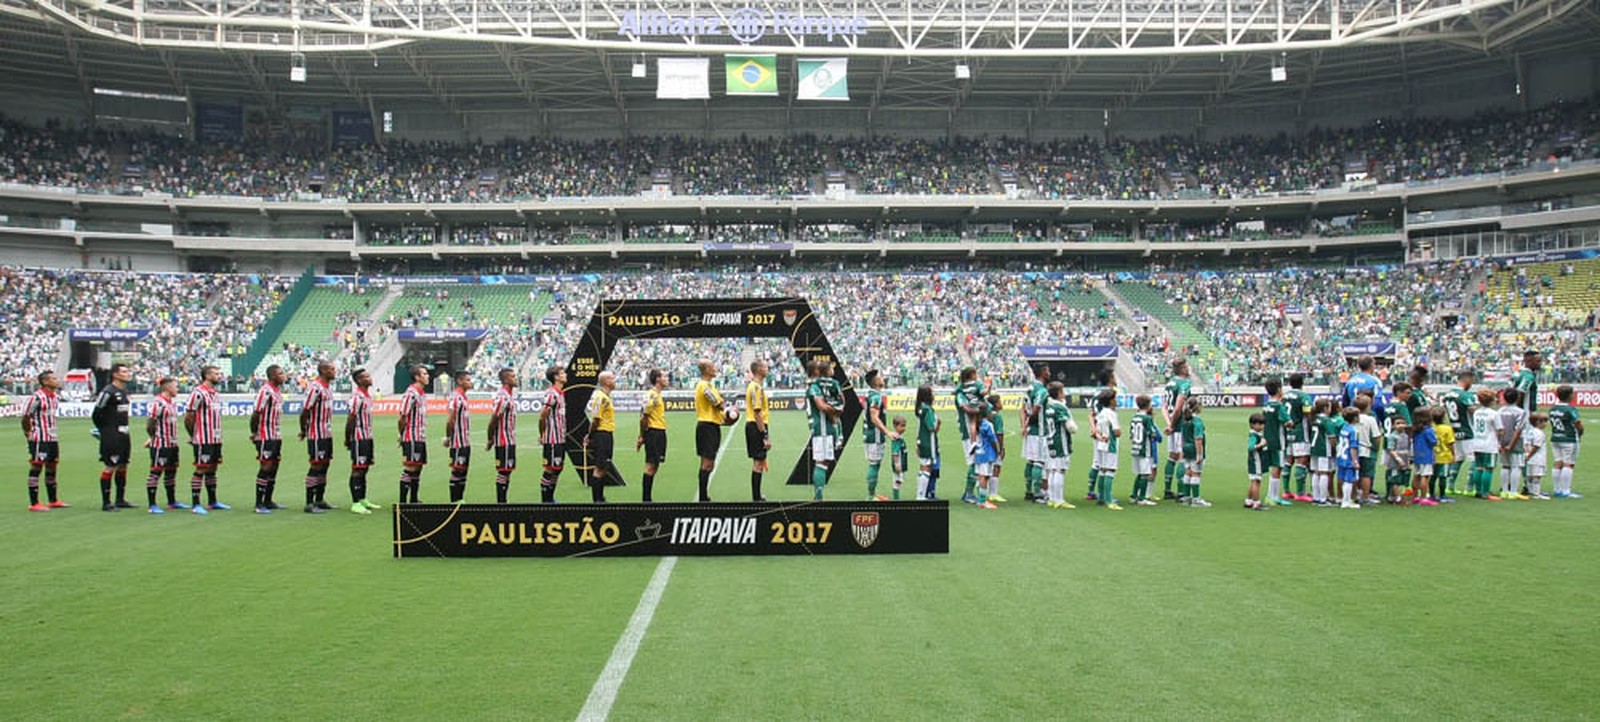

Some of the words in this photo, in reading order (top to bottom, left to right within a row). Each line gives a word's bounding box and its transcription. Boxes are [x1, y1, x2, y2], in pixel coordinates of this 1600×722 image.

[618, 12, 722, 36] Allianz
[774, 13, 869, 42] Parque
[608, 312, 681, 326] PAULISTÃO
[702, 312, 742, 326] ITAIPAVA
[747, 314, 776, 325] 2017
[1035, 348, 1058, 356] Allianz
[1069, 348, 1089, 357] Parque
[769, 401, 790, 410] 2017
[856, 514, 874, 524] FPF
[460, 516, 620, 544] PAULISTÃO
[670, 517, 757, 544] ITAIPAVA
[770, 522, 833, 543] 2017
